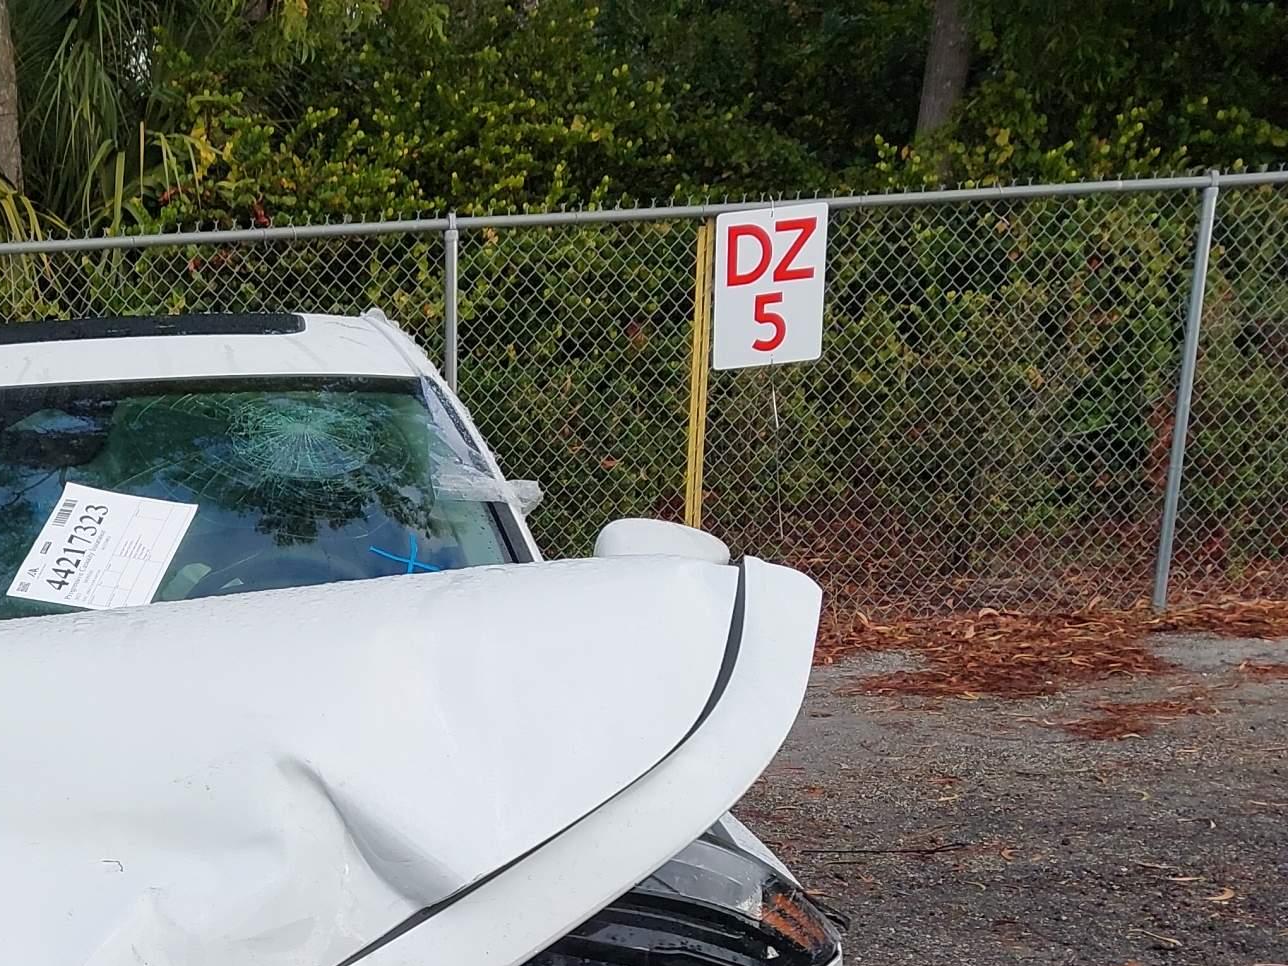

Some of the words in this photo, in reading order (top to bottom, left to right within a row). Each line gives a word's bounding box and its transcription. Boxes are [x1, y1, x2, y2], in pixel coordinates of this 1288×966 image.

[727, 217, 817, 286] DZ
[752, 292, 787, 352] 5
[46, 505, 109, 591] 44217323
